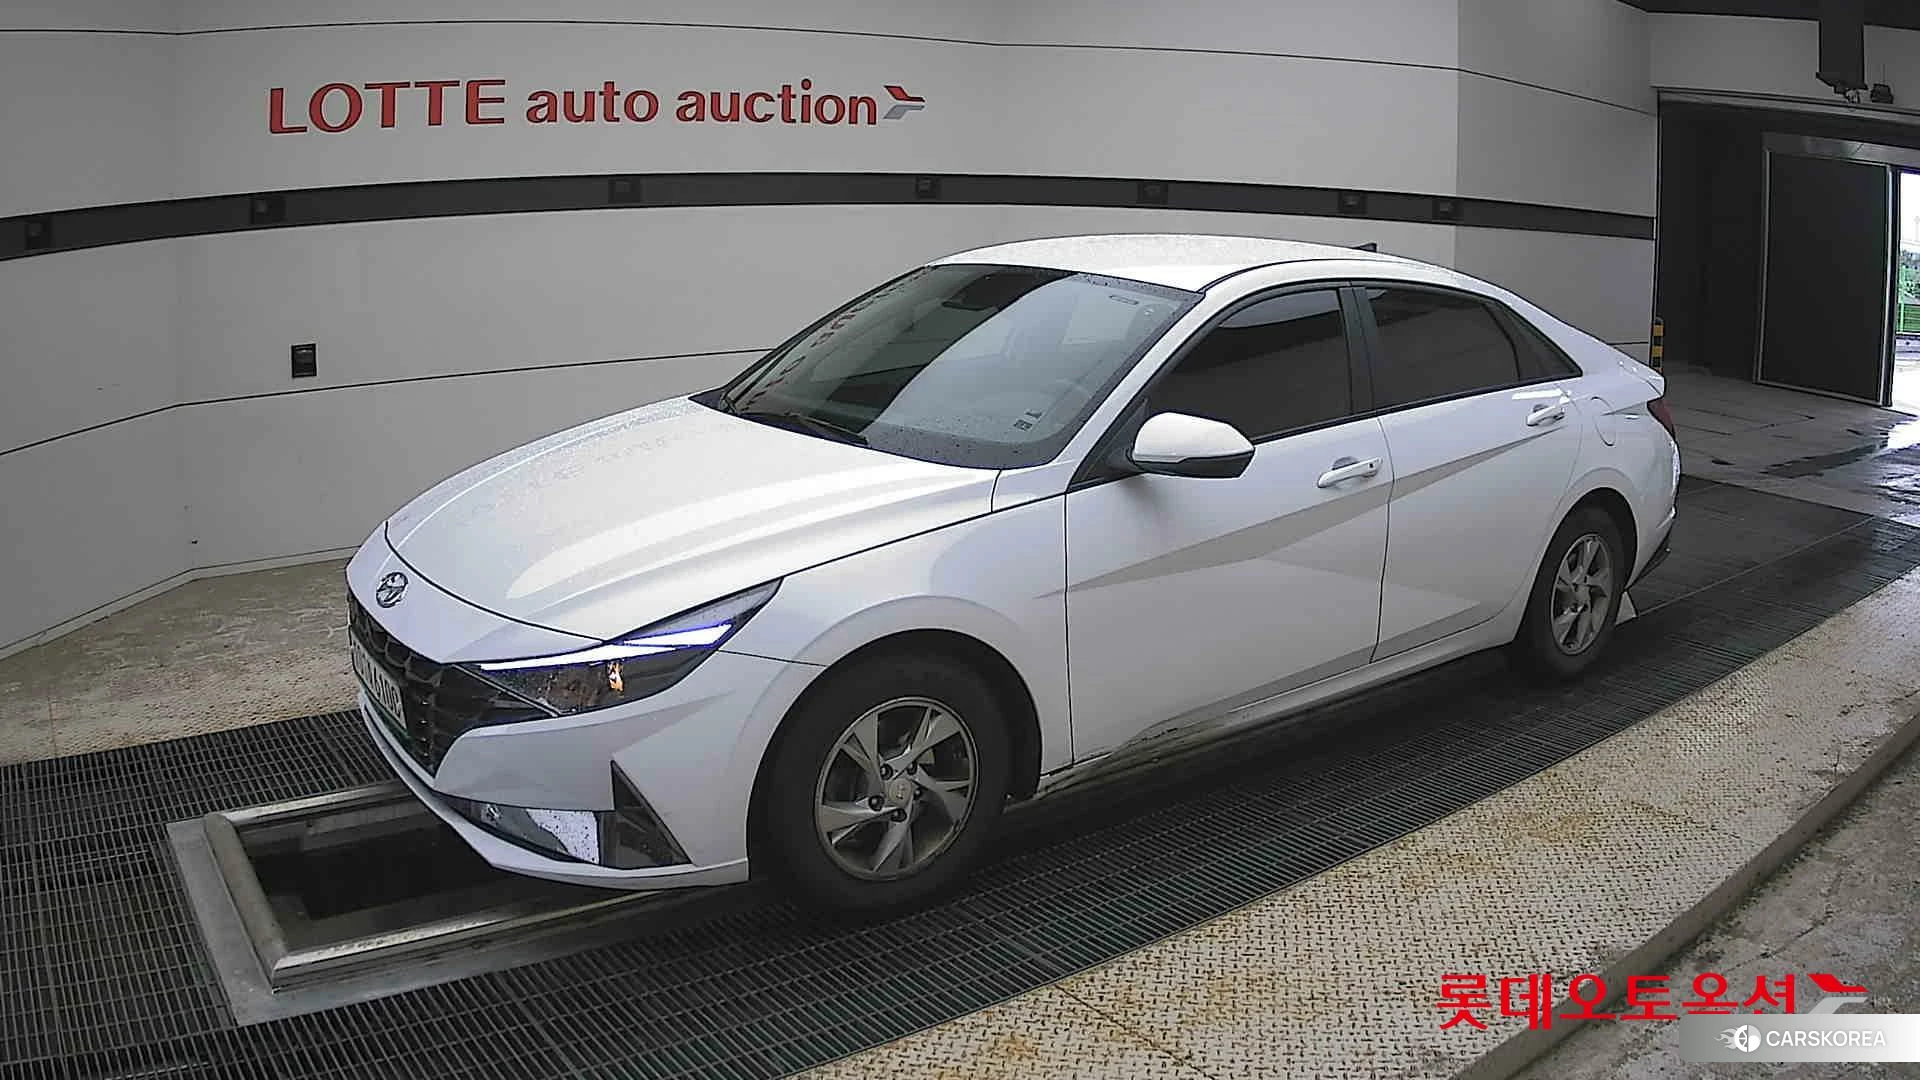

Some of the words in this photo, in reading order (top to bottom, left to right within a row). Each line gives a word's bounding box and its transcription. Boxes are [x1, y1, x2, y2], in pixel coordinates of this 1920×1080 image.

[269, 79, 505, 134] LOTTE
[525, 81, 659, 123] auto
[675, 80, 878, 125] auction
